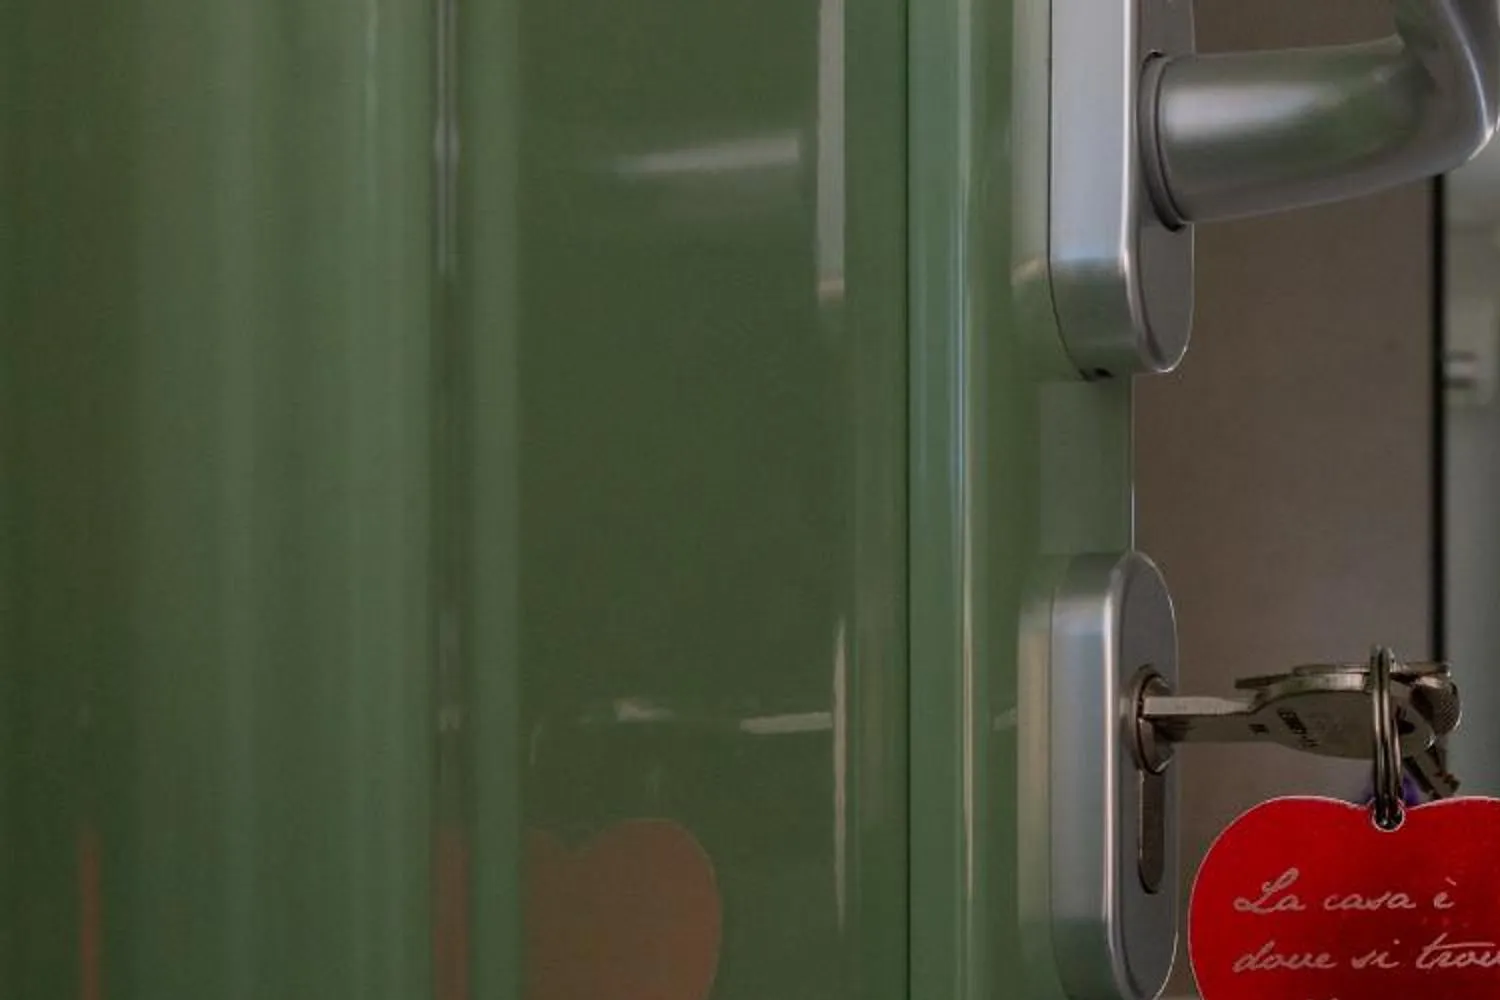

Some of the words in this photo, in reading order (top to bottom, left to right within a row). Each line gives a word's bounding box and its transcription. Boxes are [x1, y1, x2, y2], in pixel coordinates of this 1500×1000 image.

[1233, 867, 1306, 914] La
[1323, 891, 1417, 911] casa
[1433, 877, 1457, 909] è
[1232, 940, 1337, 973] dove
[1351, 939, 1400, 969] si
